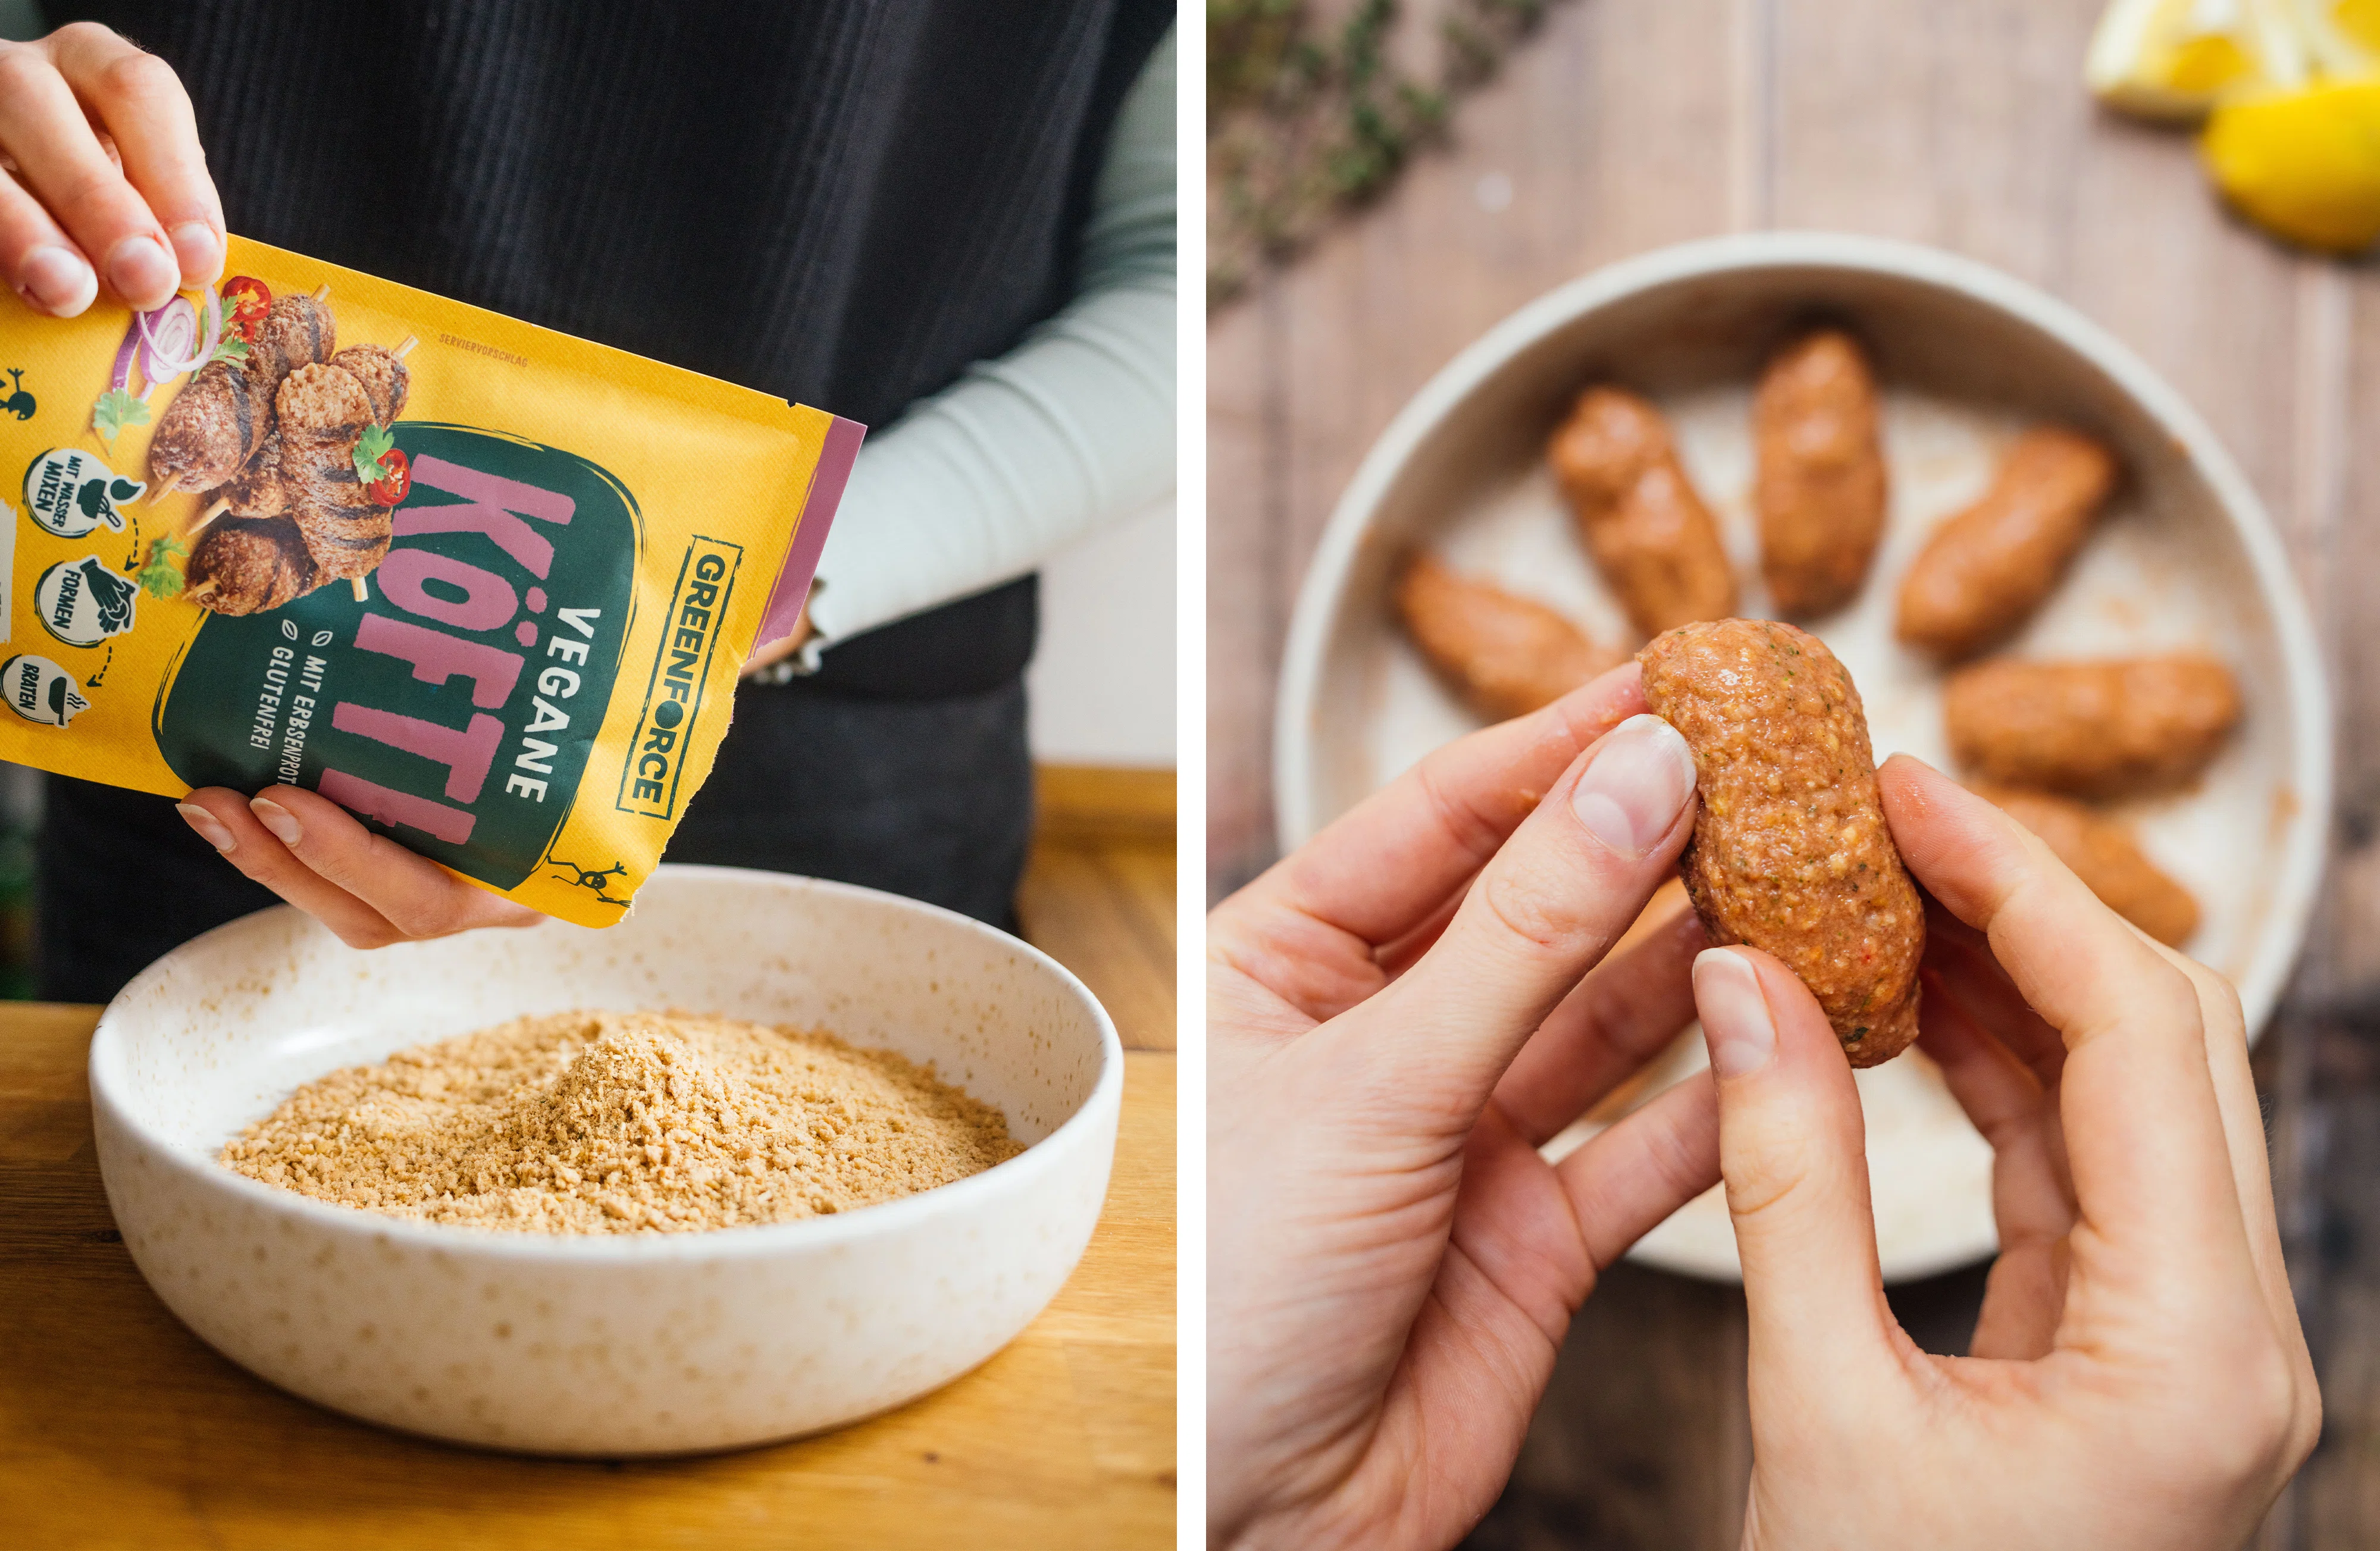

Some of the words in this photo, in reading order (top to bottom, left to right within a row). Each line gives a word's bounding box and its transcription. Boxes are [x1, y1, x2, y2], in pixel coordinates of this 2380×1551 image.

[439, 334, 528, 368] SERVIERVORSCHLAG
[35, 460, 64, 512] MIXEN
[66, 455, 82, 478] MIT
[52, 481, 74, 527] WASSER
[53, 569, 82, 629] FORMEN
[19, 663, 39, 710] BRATEN
[250, 647, 294, 750] GLUTENFREI
[300, 655, 327, 693] MIT
[632, 554, 725, 804] GREENFORCE
[506, 607, 600, 803] VEGANE
[277, 695, 316, 787] ERBSENPROT
